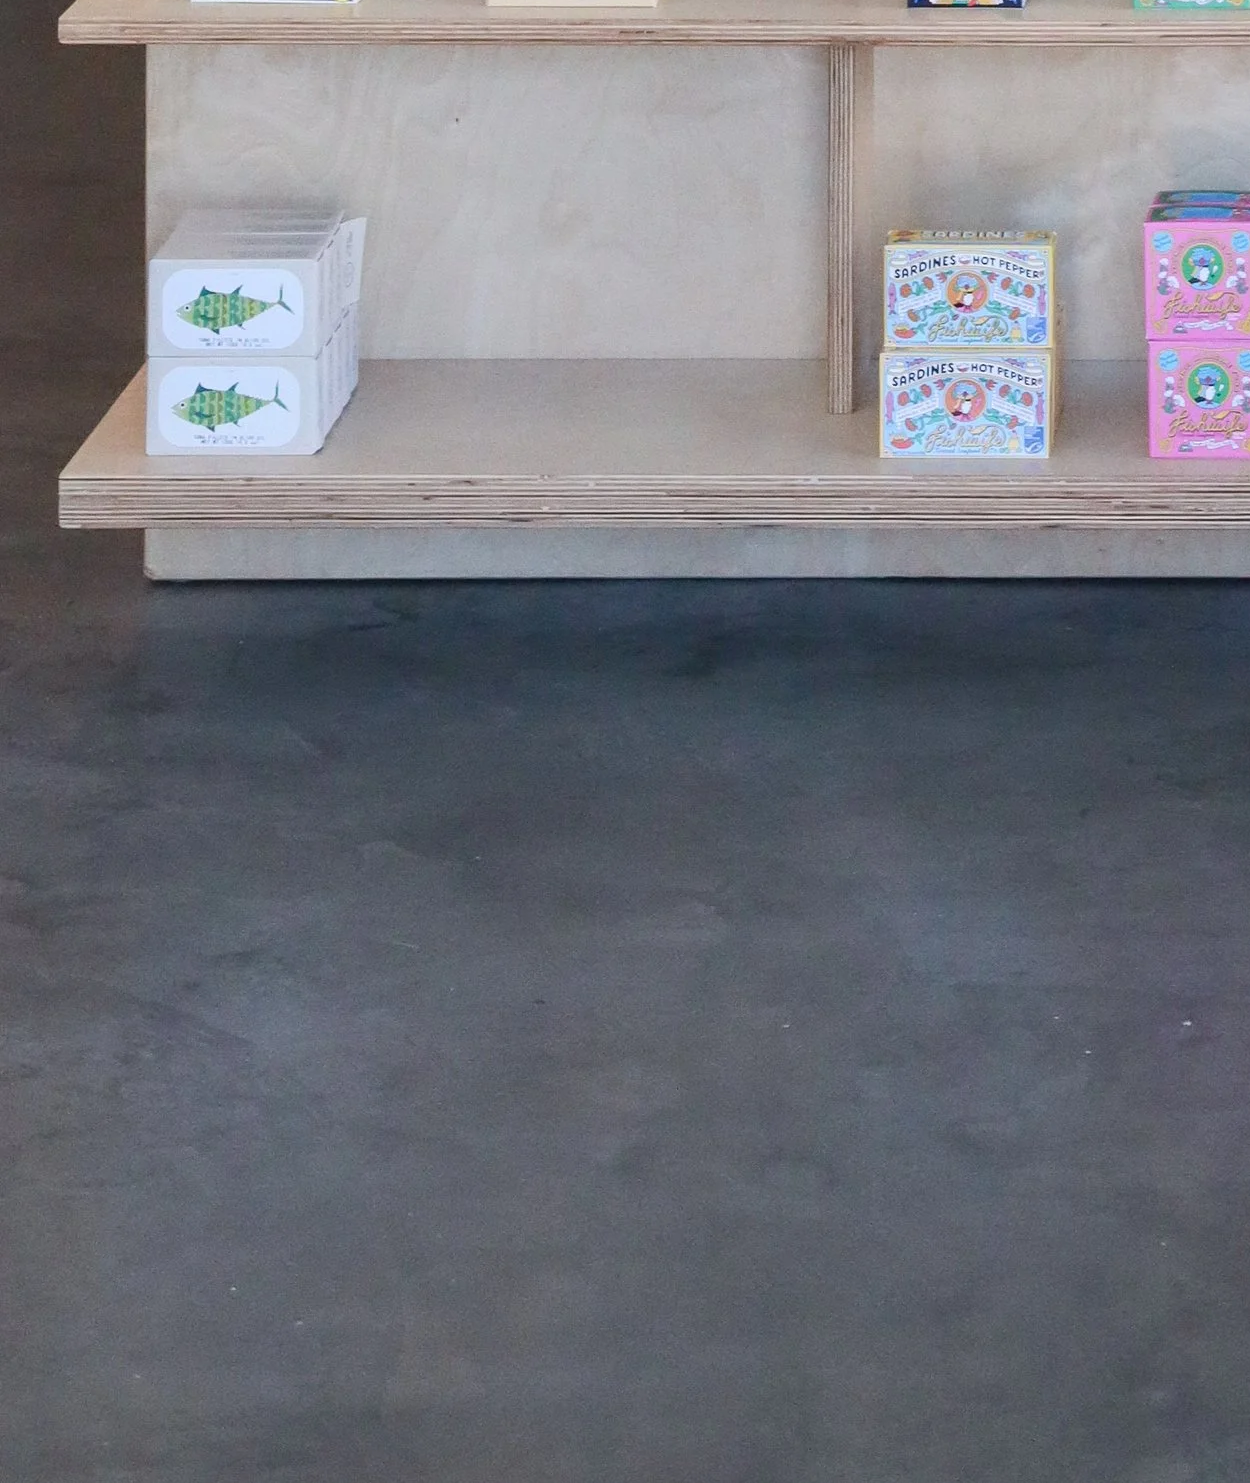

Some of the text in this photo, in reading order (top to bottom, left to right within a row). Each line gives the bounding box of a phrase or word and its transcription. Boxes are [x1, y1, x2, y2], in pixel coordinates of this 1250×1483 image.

[894, 255, 1040, 279] SARDINES HOT PEPPER
[892, 363, 1038, 387] SARDINES HOT PEPPER
